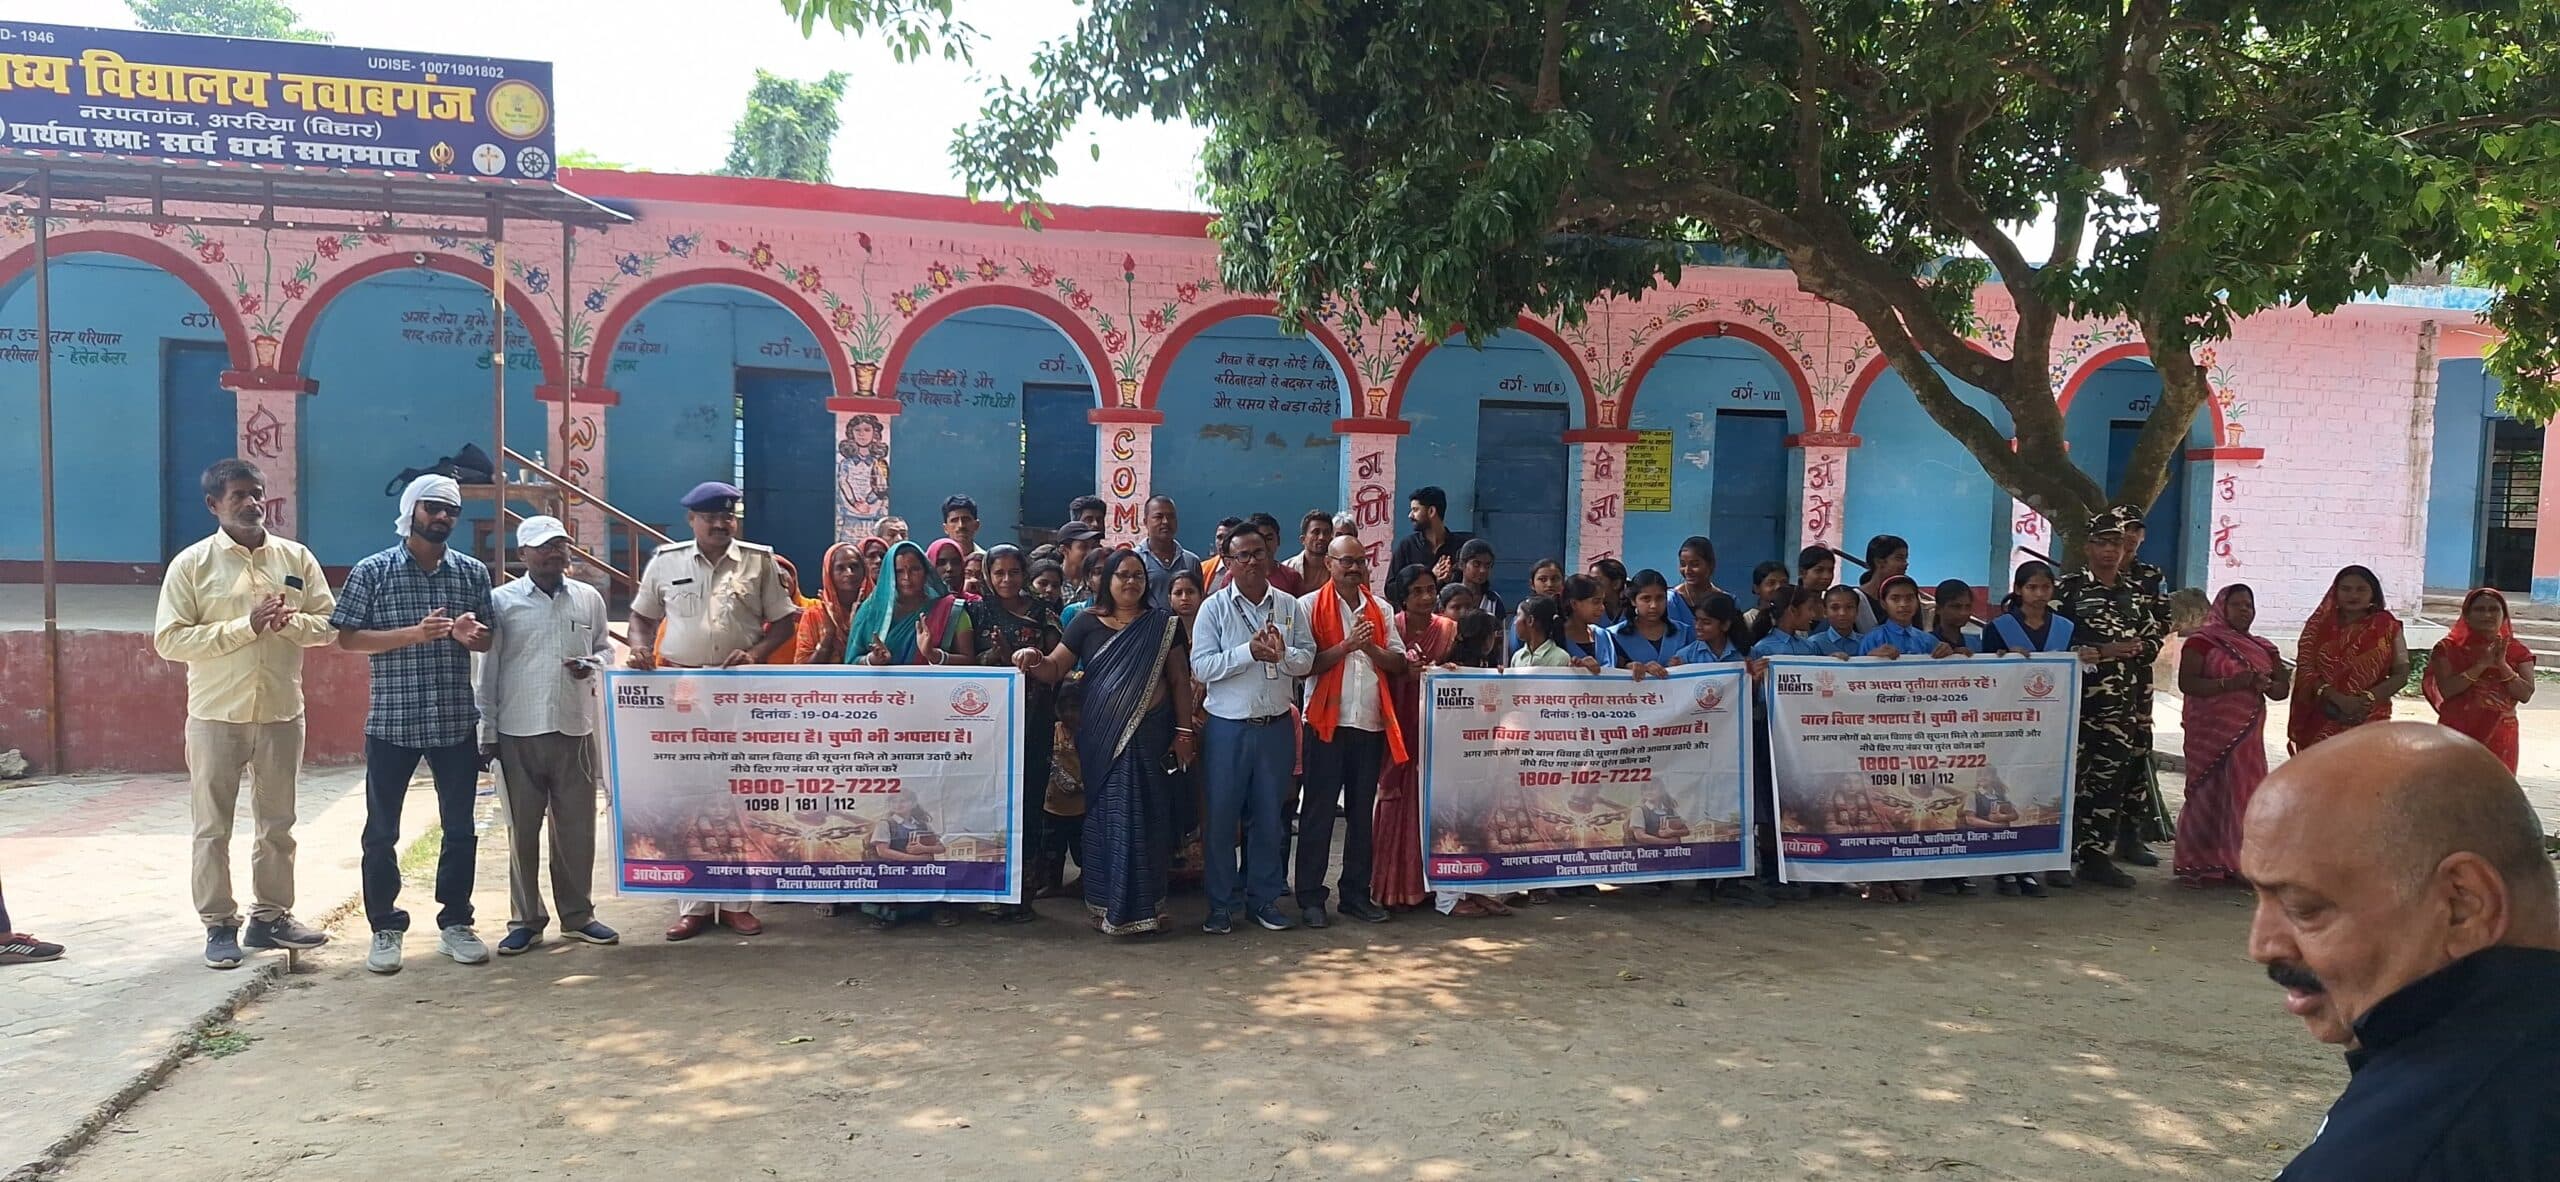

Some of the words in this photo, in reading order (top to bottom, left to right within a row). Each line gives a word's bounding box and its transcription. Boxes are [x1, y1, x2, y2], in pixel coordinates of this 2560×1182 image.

[21, 31, 54, 44] 1946
[368, 57, 416, 72] UDISE-
[419, 60, 504, 79] 10071901802
[79, 49, 272, 108] विद्यालय
[277, 73, 477, 123] नवाबगंज
[208, 111, 296, 134] अररिया
[303, 115, 383, 140] (बिहार)
[9, 119, 87, 147] प्रार्थना
[157, 130, 218, 155] सर्व
[228, 134, 286, 160] धर्म
[292, 140, 420, 168] समभाव
[401, 310, 431, 323] अगर
[78, 327, 123, 346] परिणाम
[1763, 390, 1781, 401] VIII
[1236, 398, 1266, 411] समय
[1778, 674, 1802, 683] JUST
[1847, 680, 1866, 692] इस
[1869, 680, 1901, 690] अक्षय
[1904, 677, 1937, 693] तृतीया
[1940, 676, 1970, 689] सतर्क
[618, 685, 650, 695] JUST
[1437, 687, 1464, 697] JUST
[1778, 683, 1813, 692] RIGHTS
[618, 695, 664, 706] RIGHTS
[712, 692, 738, 707] इस
[743, 692, 786, 704] अक्षय
[791, 690, 837, 708] तृतीया
[842, 690, 883, 704] सतर्क
[888, 689, 906, 706] रहें
[1437, 697, 1474, 706] RIGHTS
[1512, 694, 1530, 706] इस
[1533, 694, 1566, 705] अक्षय
[1568, 692, 1603, 709] तृतीया
[1606, 692, 1637, 705] सतर्क
[751, 708, 791, 720] दिनांक
[802, 710, 877, 720] 19-04-2026
[1540, 709, 1570, 719] दिनांक
[1577, 710, 1636, 719] 19-04-2026
[1801, 714, 1828, 725] बाल
[1832, 711, 1865, 725] विवाह
[1868, 713, 1909, 724] अपराध
[1961, 709, 1978, 723] भी
[1982, 710, 2023, 723] अपराध
[650, 730, 687, 743] बाल
[691, 727, 737, 743] विवाह
[742, 731, 800, 744] अपराध
[828, 728, 862, 748] चुप्पी
[867, 728, 889, 744] भी
[894, 731, 950, 744] अपराध
[1462, 728, 1489, 741] बाल
[1492, 726, 1530, 741] विवाह
[1534, 729, 1577, 742] अपराध
[1600, 725, 1627, 745] चुप्पी
[1631, 725, 1649, 739] भी
[1652, 723, 1692, 737] अपराध
[653, 753, 676, 761] अगर
[678, 753, 700, 762] आप
[704, 751, 729, 761] लोगों
[731, 751, 746, 761] को
[748, 753, 769, 761] बाल
[772, 751, 802, 762] विवाह
[805, 751, 819, 761] की
[822, 753, 850, 764] सूचना
[853, 751, 875, 761] मिले
[877, 751, 888, 761] तो
[890, 753, 924, 761] आवाज
[953, 751, 972, 761] और
[1858, 754, 1987, 771] 1800-102-7222
[730, 763, 751, 773] नीचे
[753, 764, 772, 773] दिए
[774, 765, 790, 773] गए
[792, 764, 814, 773] नंबर
[816, 765, 829, 773] पर
[832, 764, 853, 775] तुरंत
[855, 763, 879, 773] कॉल
[1518, 767, 1652, 787] 1800-102-7222
[1871, 773, 1897, 786] 1098
[1909, 773, 1926, 785] 181
[1938, 773, 1954, 784] 112
[728, 777, 901, 795] 1800-102-7222
[745, 798, 779, 811] 1098
[795, 798, 817, 811] 181
[834, 797, 855, 810] 112
[706, 865, 743, 876] जागरण
[745, 866, 782, 877] कल्याण
[912, 864, 946, 876] अररिया
[1437, 860, 1483, 874] आयोजक
[632, 866, 685, 882] आयोजक
[777, 878, 803, 889] जिला
[805, 879, 841, 889] प्रशासन
[843, 879, 878, 889] अररिया
